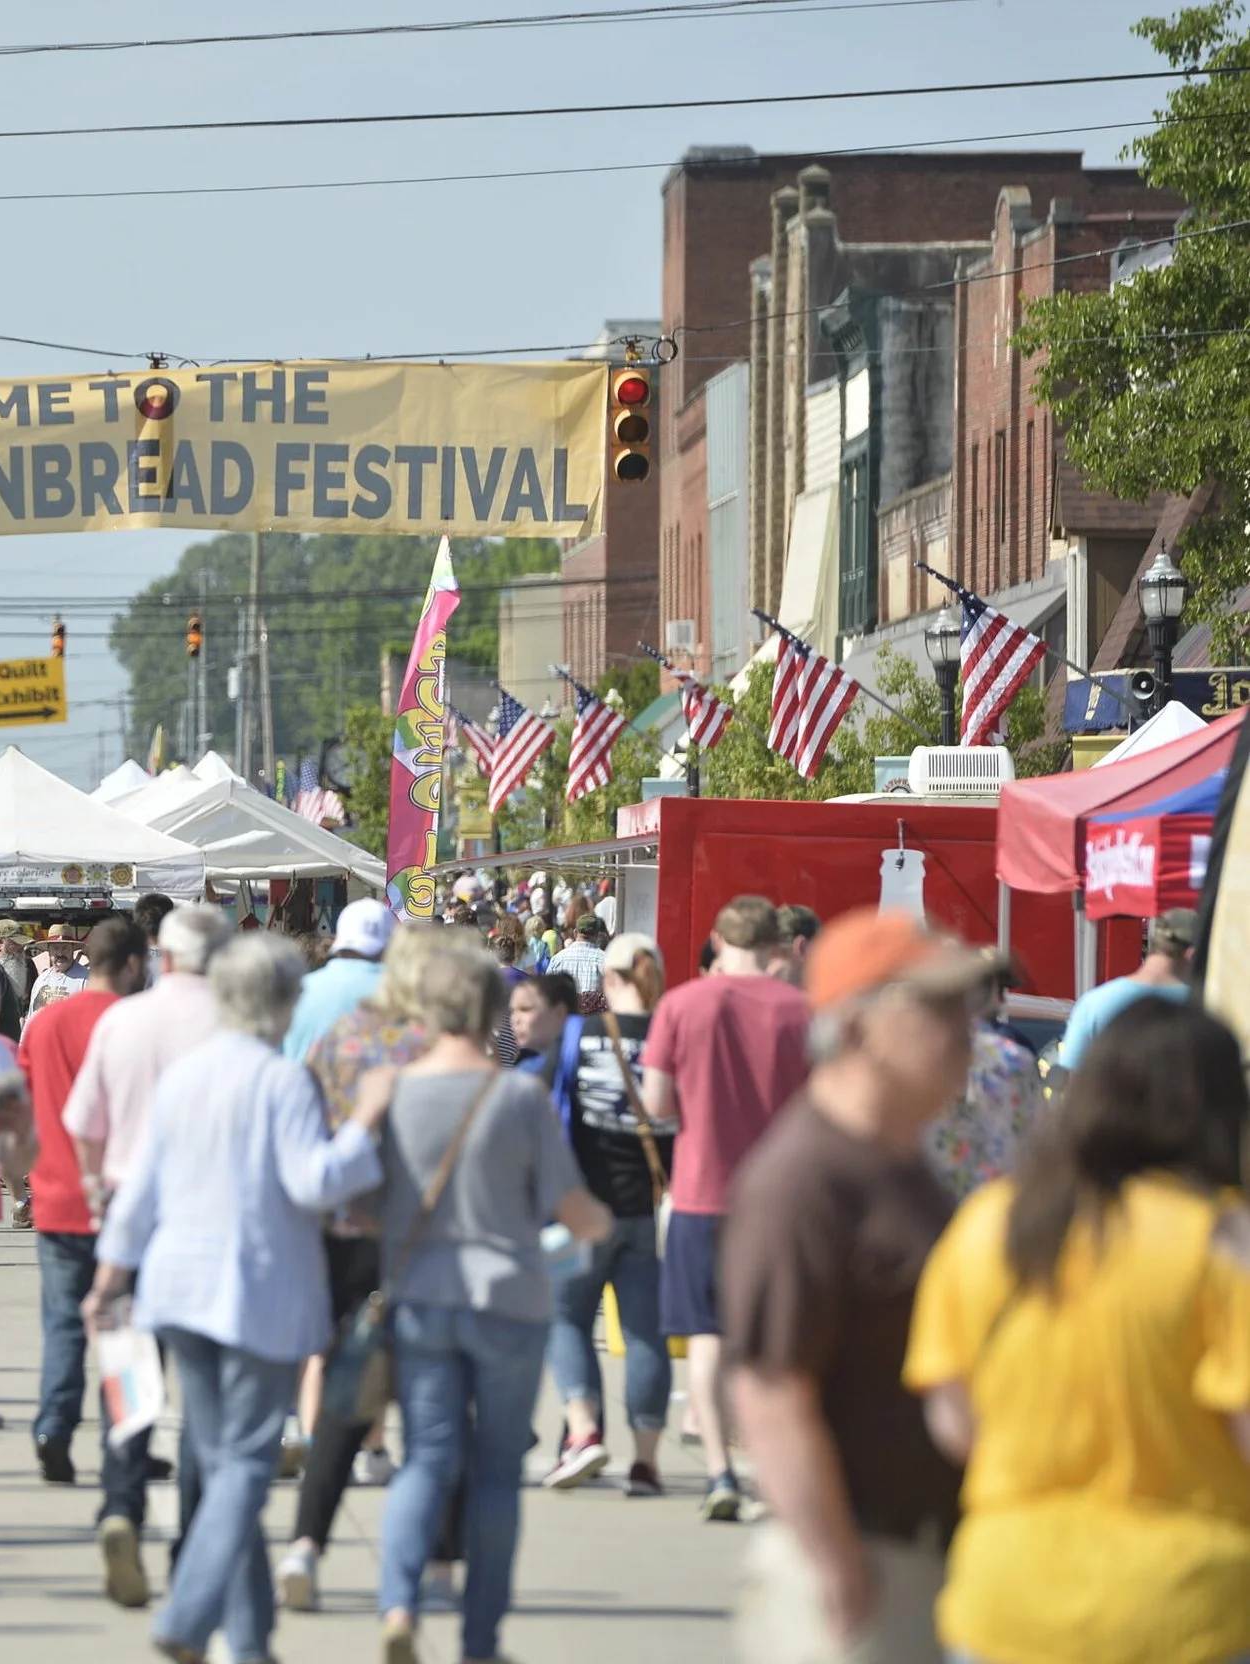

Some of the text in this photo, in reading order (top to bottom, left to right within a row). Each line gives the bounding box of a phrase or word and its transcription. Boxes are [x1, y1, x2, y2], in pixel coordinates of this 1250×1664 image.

[90, 377, 180, 424] TO
[196, 370, 330, 425] THE
[274, 443, 589, 522] FESTIVAL
